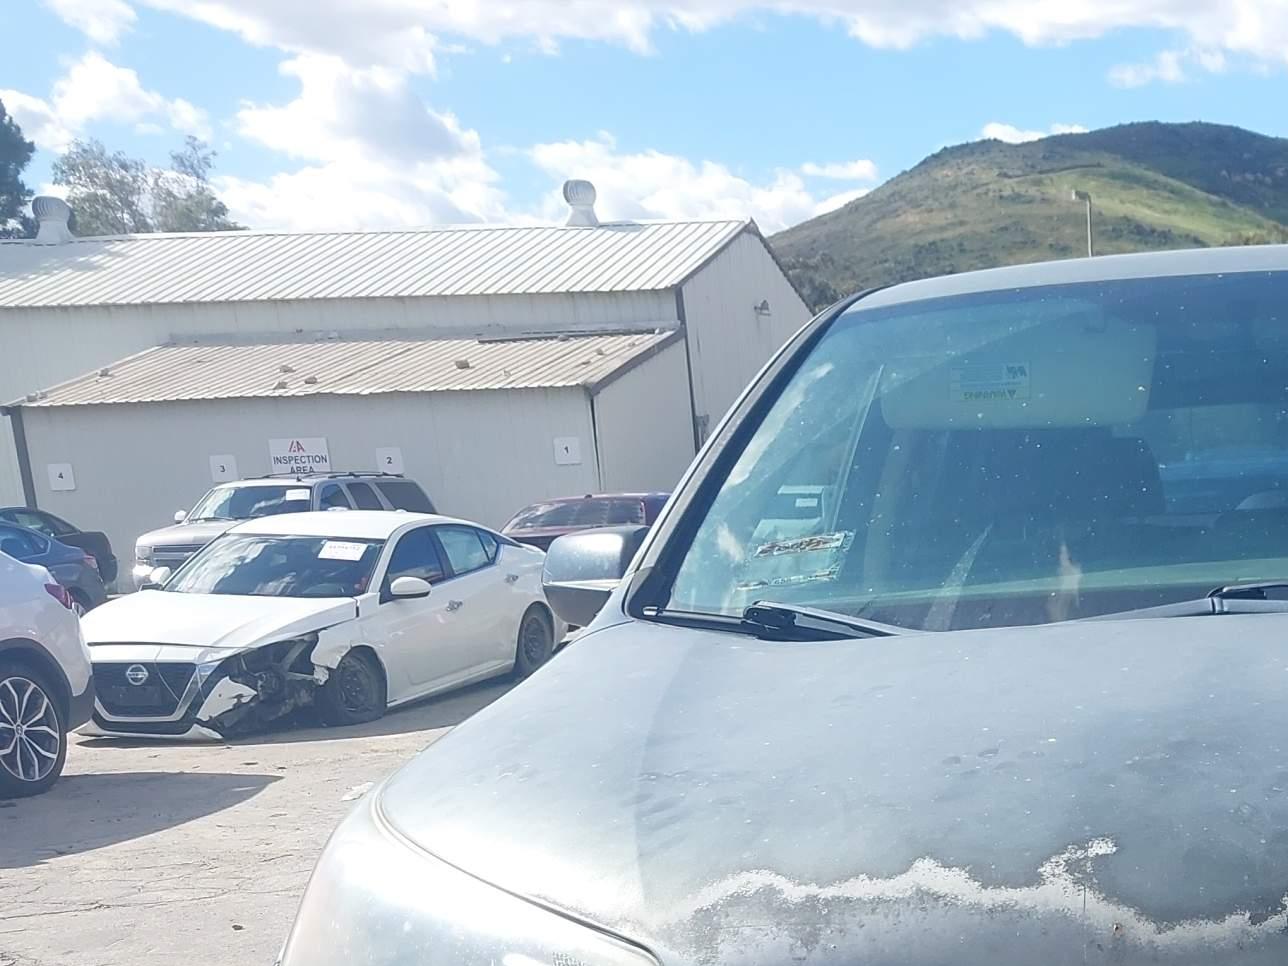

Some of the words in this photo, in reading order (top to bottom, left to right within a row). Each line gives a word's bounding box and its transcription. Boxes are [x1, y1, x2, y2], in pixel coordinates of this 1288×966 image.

[272, 454, 328, 465] INSPECTION
[386, 456, 393, 465] 2
[219, 465, 226, 473] 3
[290, 465, 316, 474] AREA
[57, 472, 64, 480] 4
